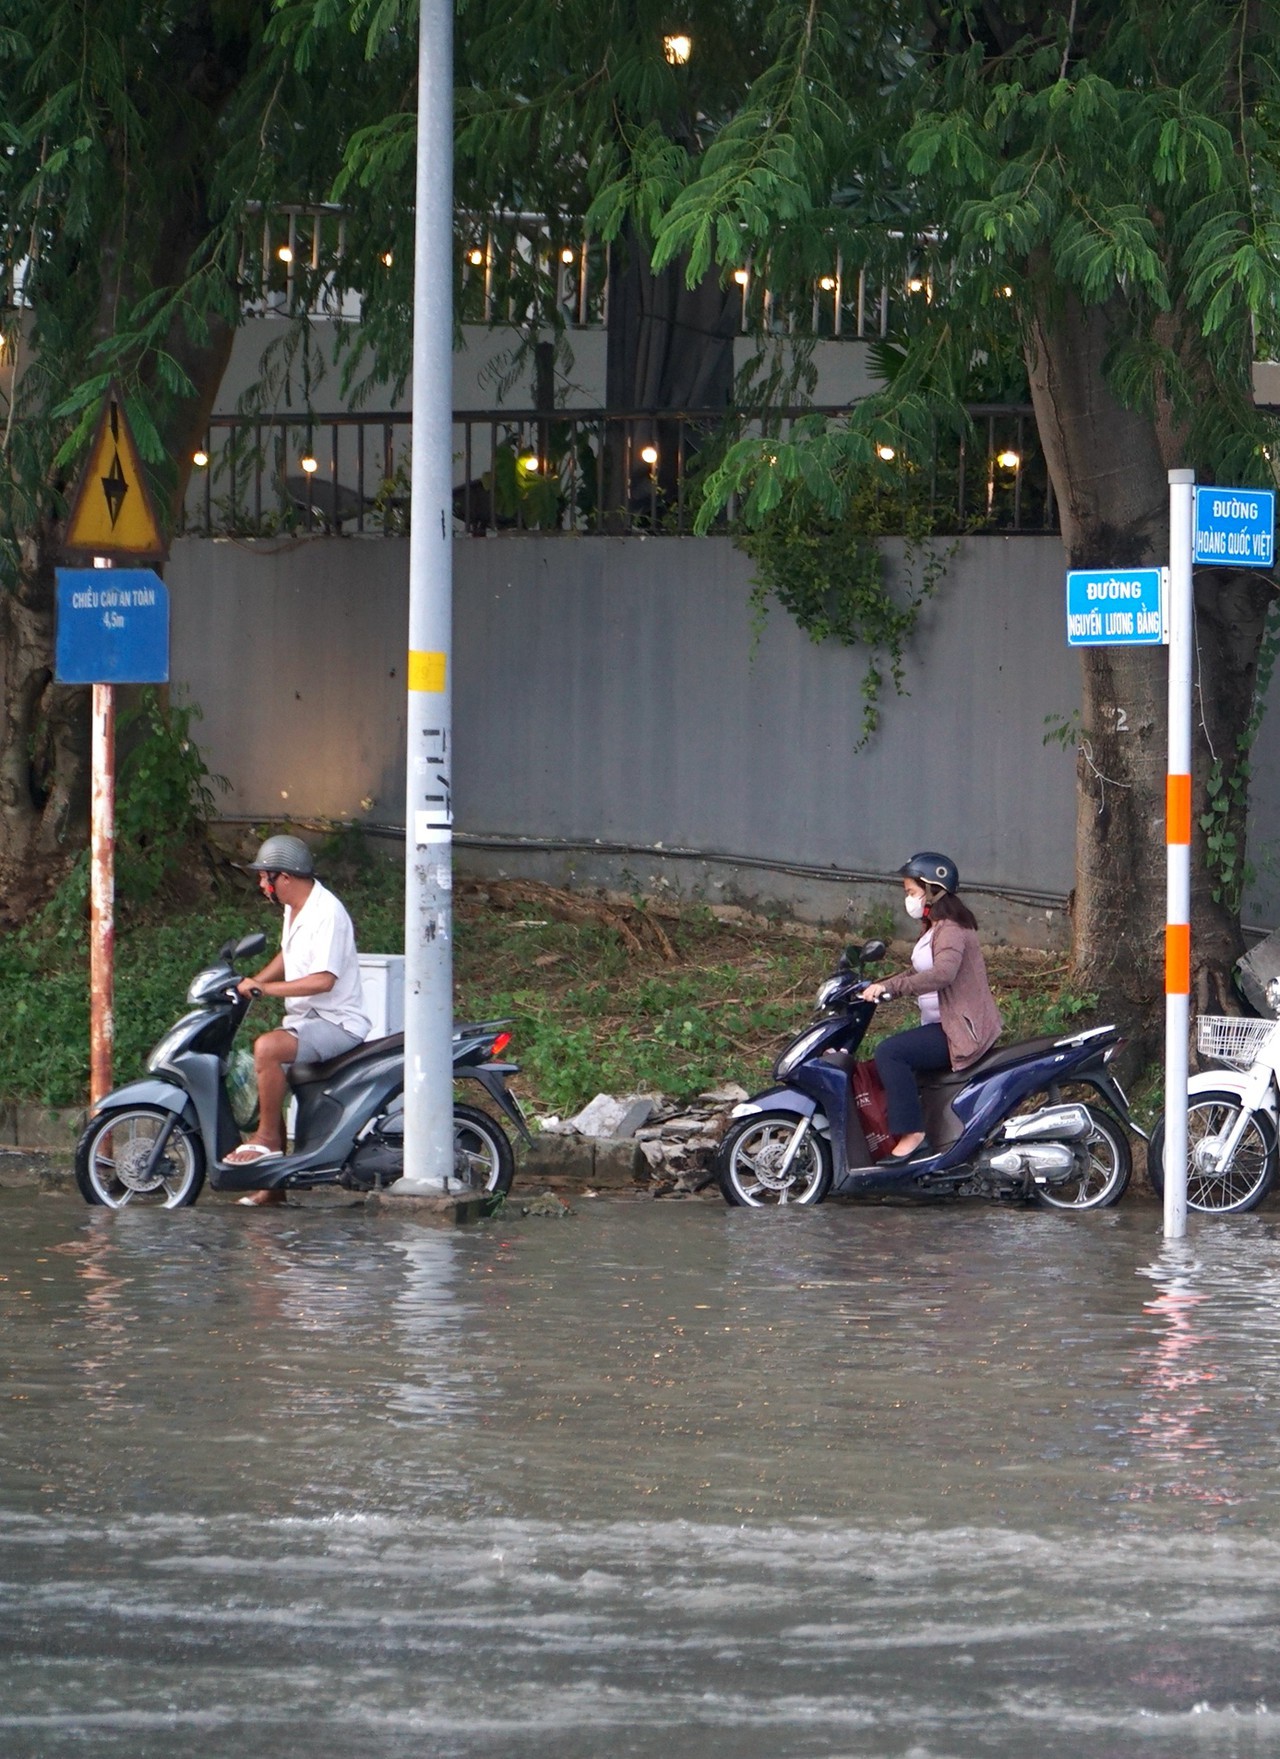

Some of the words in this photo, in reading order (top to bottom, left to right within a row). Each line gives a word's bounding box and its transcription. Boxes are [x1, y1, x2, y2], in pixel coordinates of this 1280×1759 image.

[1212, 497, 1258, 520] ĐƯỜNG
[1197, 525, 1226, 554] HOÀNG
[1228, 525, 1251, 556] QUỐC
[1252, 530, 1271, 560] VIỆT
[72, 585, 99, 609] CHIỀU
[119, 590, 131, 608] AN
[132, 586, 155, 606] TOÀN
[1086, 578, 1142, 600] ĐƯỜNG
[102, 611, 125, 629] 4,5m
[1069, 606, 1102, 636] NGUYỄN
[1105, 611, 1134, 635] LƯƠNG
[1136, 602, 1159, 635] BẰNG
